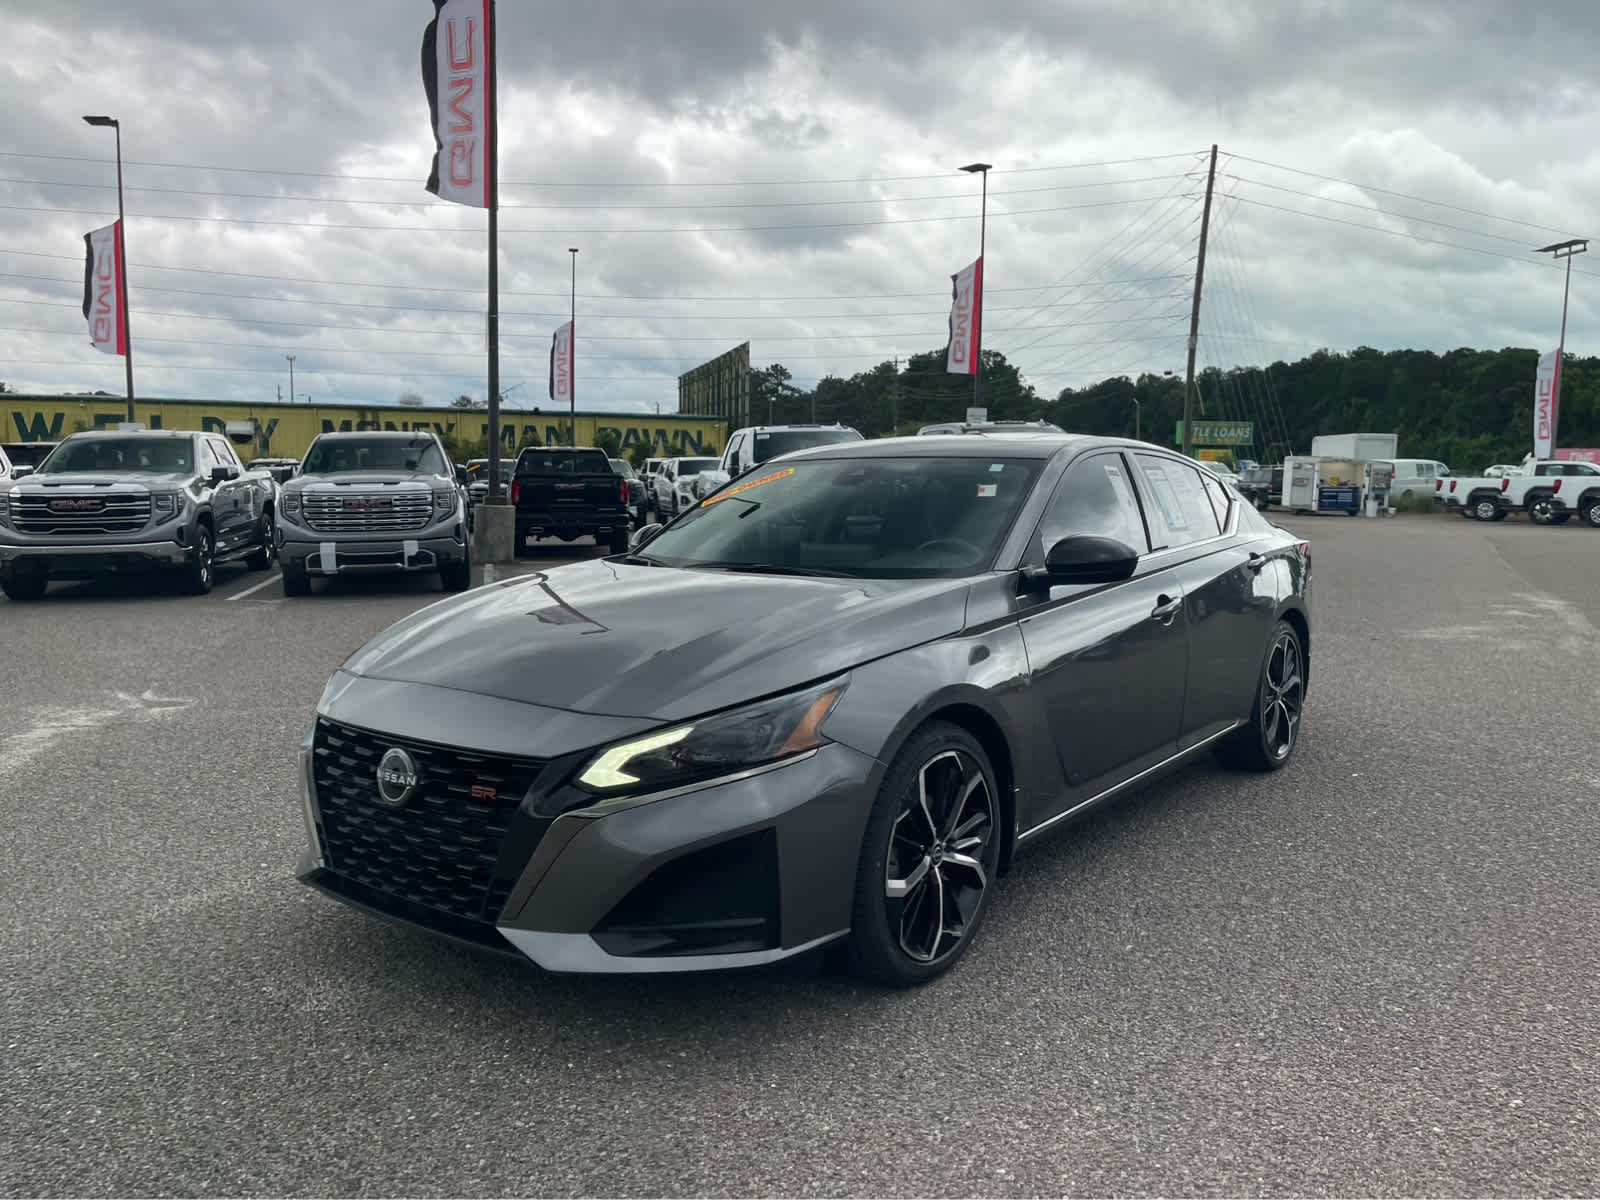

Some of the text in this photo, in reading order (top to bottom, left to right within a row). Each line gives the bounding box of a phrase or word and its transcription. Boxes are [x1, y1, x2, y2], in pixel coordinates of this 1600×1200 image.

[1214, 426, 1250, 438] LOANS
[377, 767, 417, 786] SSAN
[471, 785, 497, 800] SR
